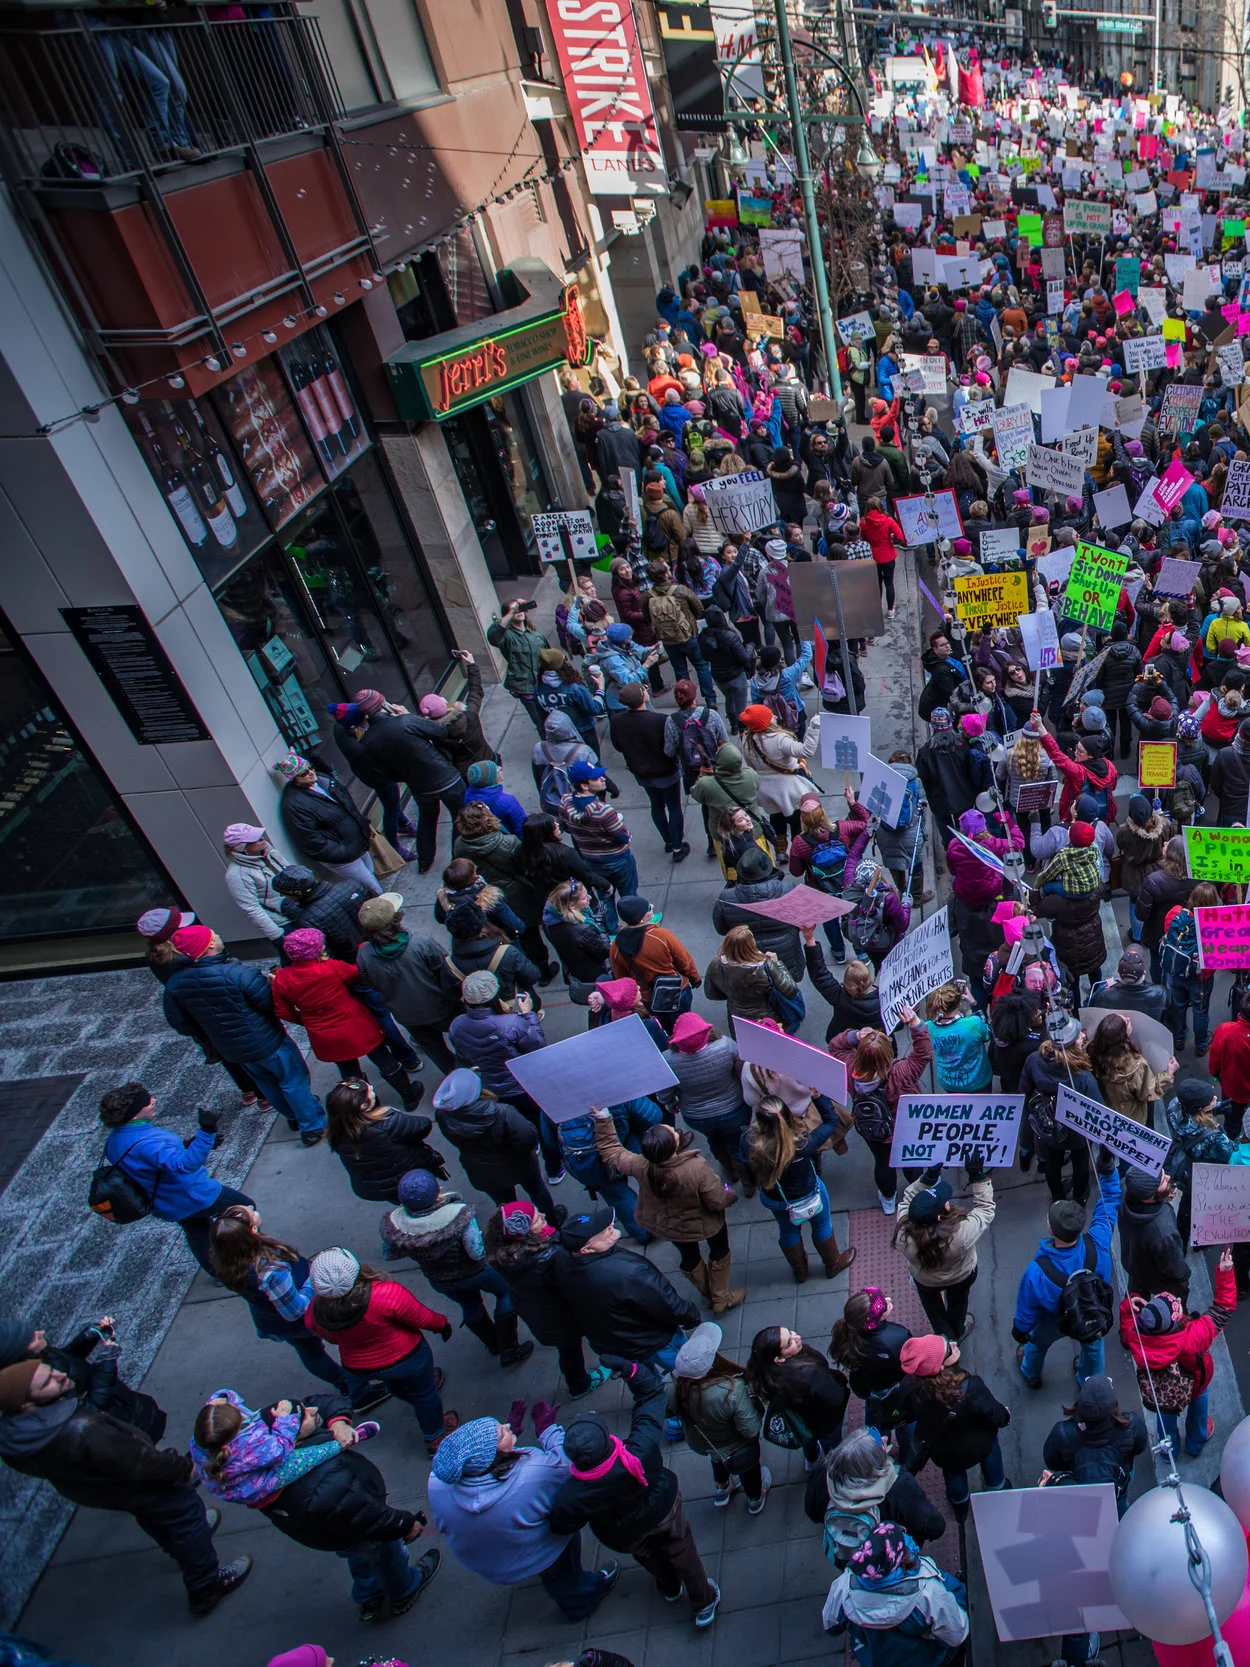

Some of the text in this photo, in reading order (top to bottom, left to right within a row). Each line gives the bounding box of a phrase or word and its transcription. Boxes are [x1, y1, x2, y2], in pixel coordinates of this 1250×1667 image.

[720, 33, 754, 60] H&M
[557, 0, 654, 145] STRIKE
[592, 159, 656, 172] LANES
[1086, 213, 1101, 221] NOT
[505, 327, 558, 354] TOBACCO SHOP
[974, 416, 990, 427] HER
[1162, 406, 1198, 417] RESPECT
[702, 471, 765, 490] If you FEEL
[532, 513, 570, 522] CANCEL
[1079, 545, 1126, 571] I Won't
[957, 586, 1005, 605] ANYWHERE
[994, 600, 1025, 612] Justice
[1082, 589, 1102, 608] OR
[961, 610, 1024, 631] EVERYWHERE
[1062, 596, 1114, 630] BEHAVE
[1040, 647, 1057, 668] LET'S
[1192, 829, 1203, 842] A
[1195, 855, 1220, 869] Is
[1229, 859, 1244, 871] in
[888, 959, 928, 996] MARCHING
[926, 965, 953, 991] RIGHTS
[908, 1103, 1017, 1121] WOMEN ARE
[1063, 1090, 1078, 1104] WE
[1080, 1100, 1102, 1116] NEED
[917, 1122, 1001, 1144] PEOPLE,
[1083, 1110, 1138, 1147] NOT A
[901, 1142, 1008, 1164] NOT PREY!
